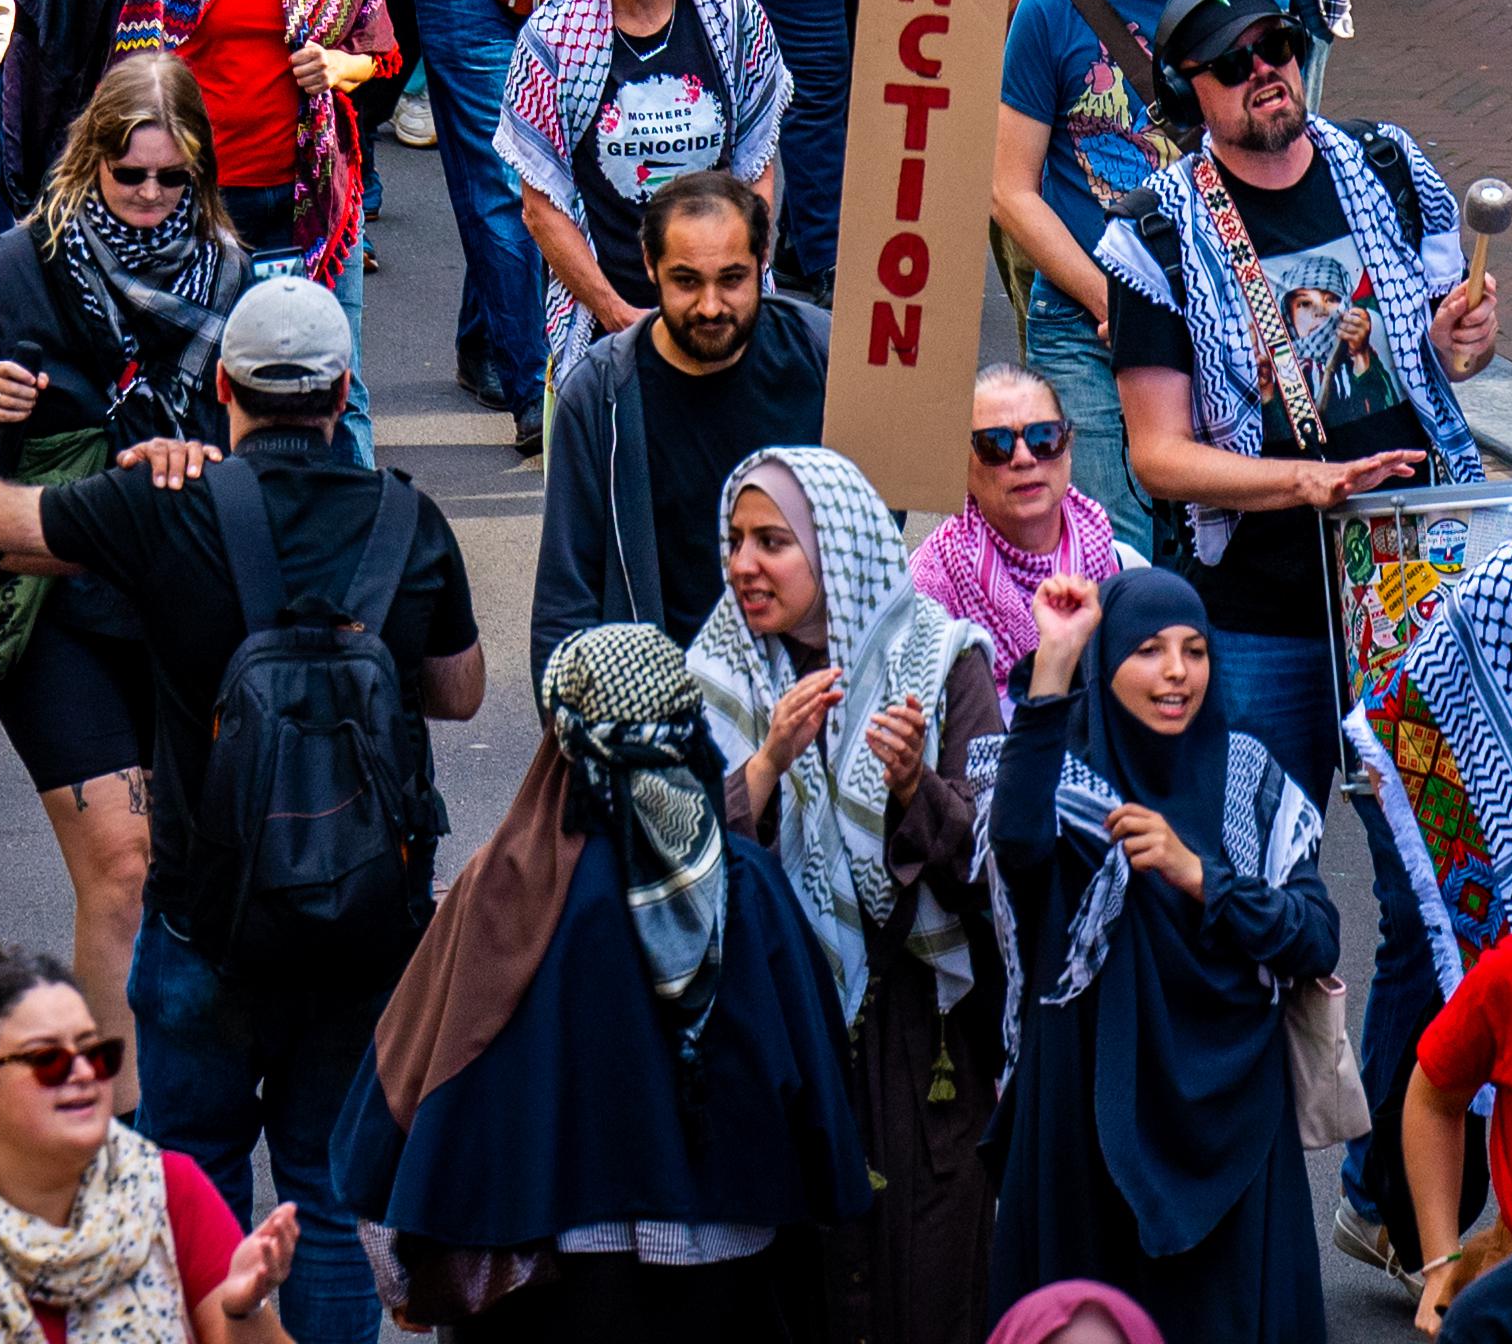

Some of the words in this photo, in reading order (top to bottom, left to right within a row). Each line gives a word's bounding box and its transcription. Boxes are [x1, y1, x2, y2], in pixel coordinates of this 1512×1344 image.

[626, 106, 692, 126] MOTHERS
[631, 121, 693, 139] AGAINST
[607, 132, 722, 160] GENOCIDE
